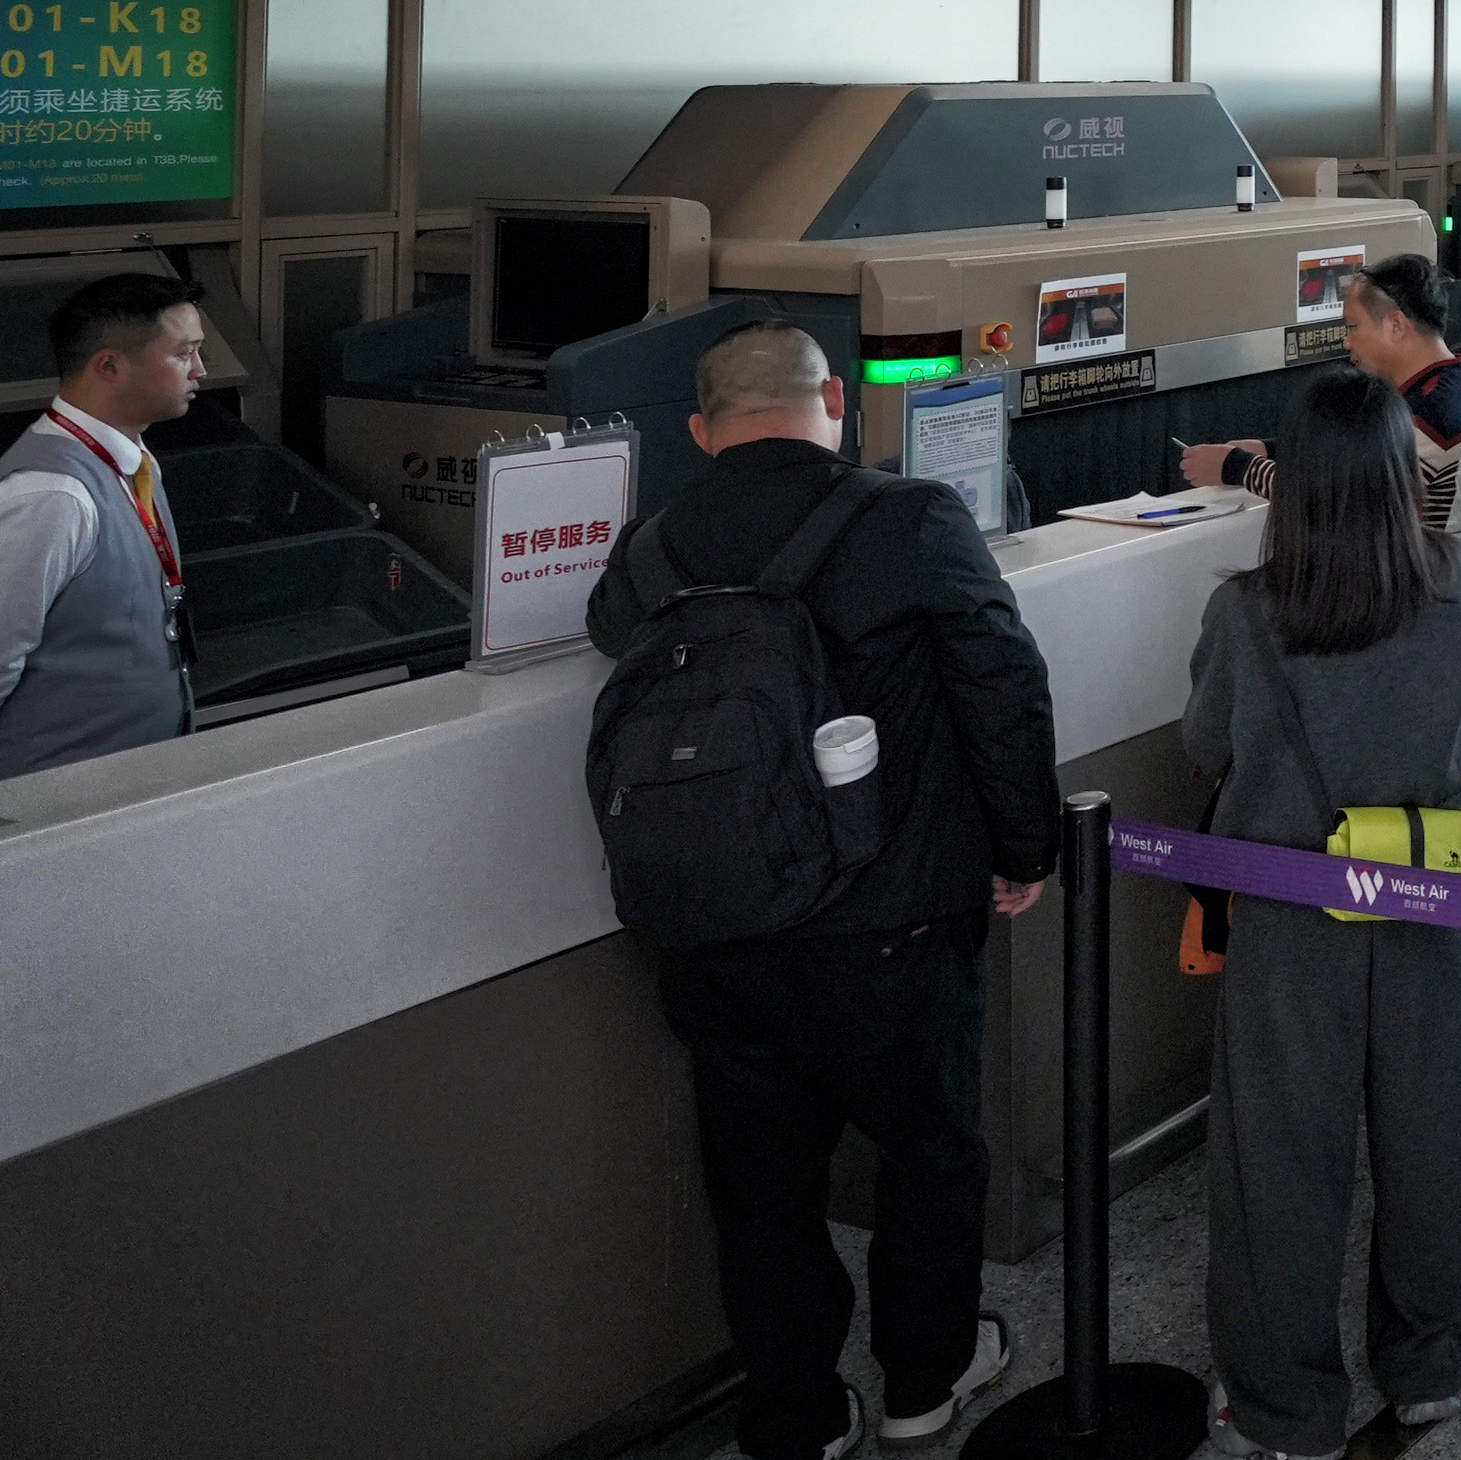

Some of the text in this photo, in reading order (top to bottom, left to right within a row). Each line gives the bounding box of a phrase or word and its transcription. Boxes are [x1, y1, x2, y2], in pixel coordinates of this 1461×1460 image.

[1080, 116, 1125, 139] 威视
[87, 156, 131, 168] located
[1043, 143, 1125, 159] NUCTECH
[501, 520, 612, 558] 暂停服务
[501, 558, 609, 583] Out of Service
[1121, 834, 1173, 855] West Air
[1391, 879, 1449, 901] West Air
